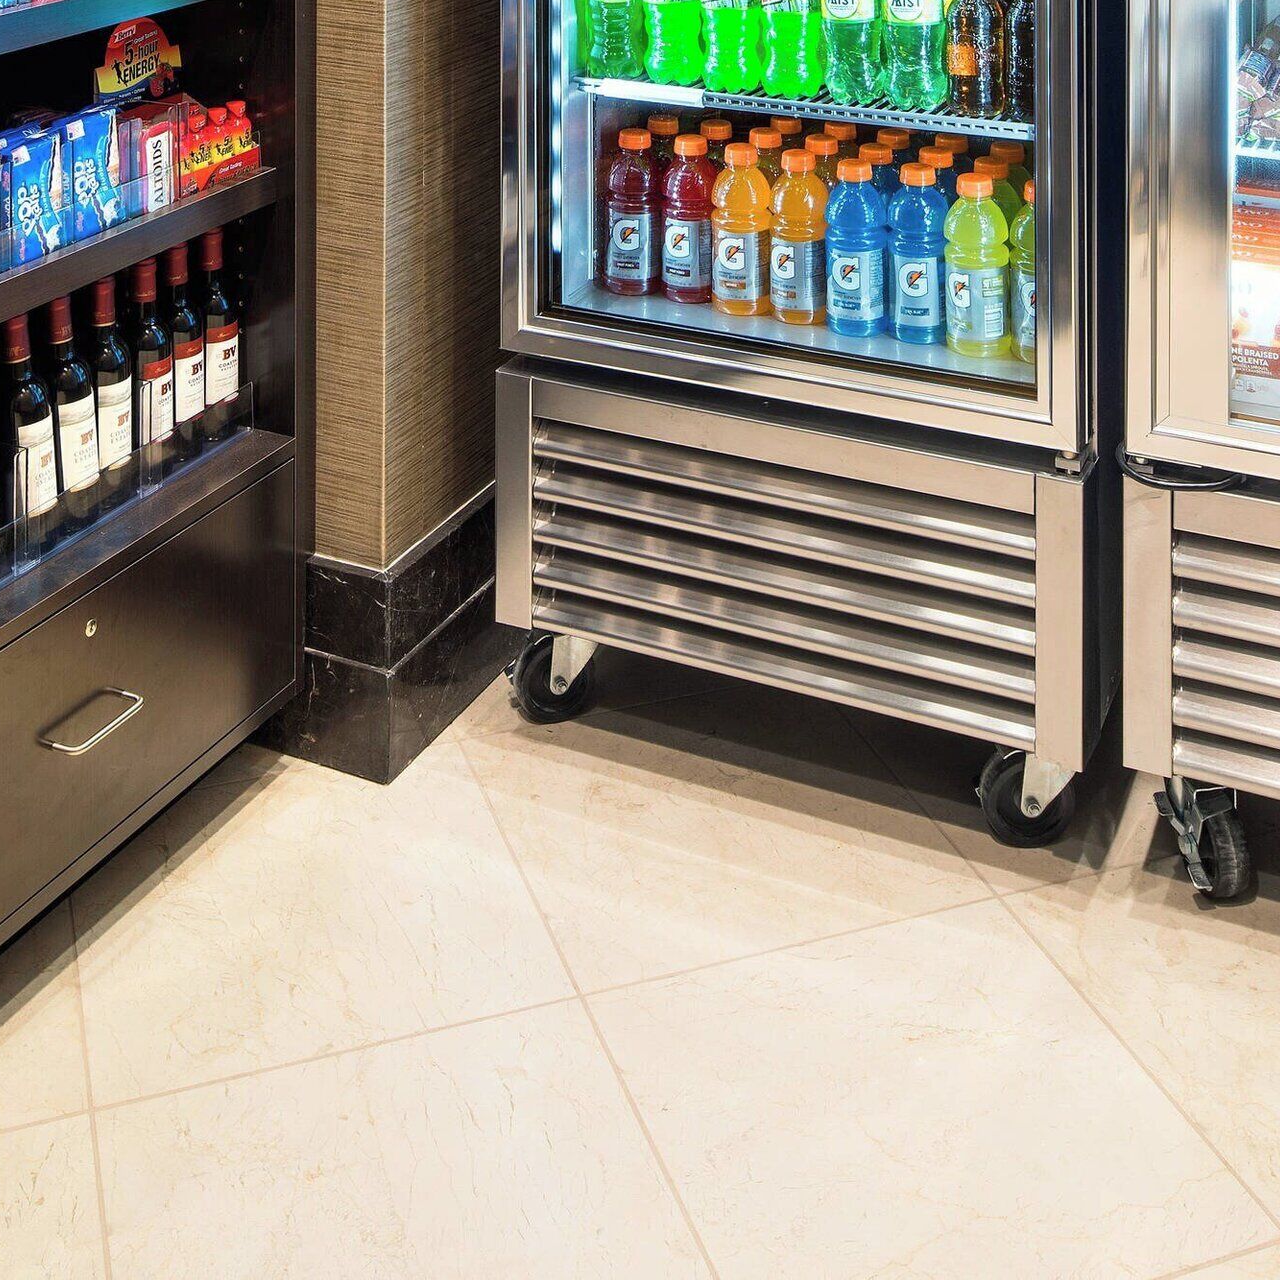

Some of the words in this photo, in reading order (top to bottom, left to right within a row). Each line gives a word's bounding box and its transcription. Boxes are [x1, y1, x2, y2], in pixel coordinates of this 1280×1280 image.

[124, 39, 159, 66] 5-hour
[123, 52, 161, 84] ENERGY
[152, 138, 165, 204] ALTOIDS
[1232, 355, 1269, 367] POLENTA
[1243, 349, 1280, 361] BRAISED
